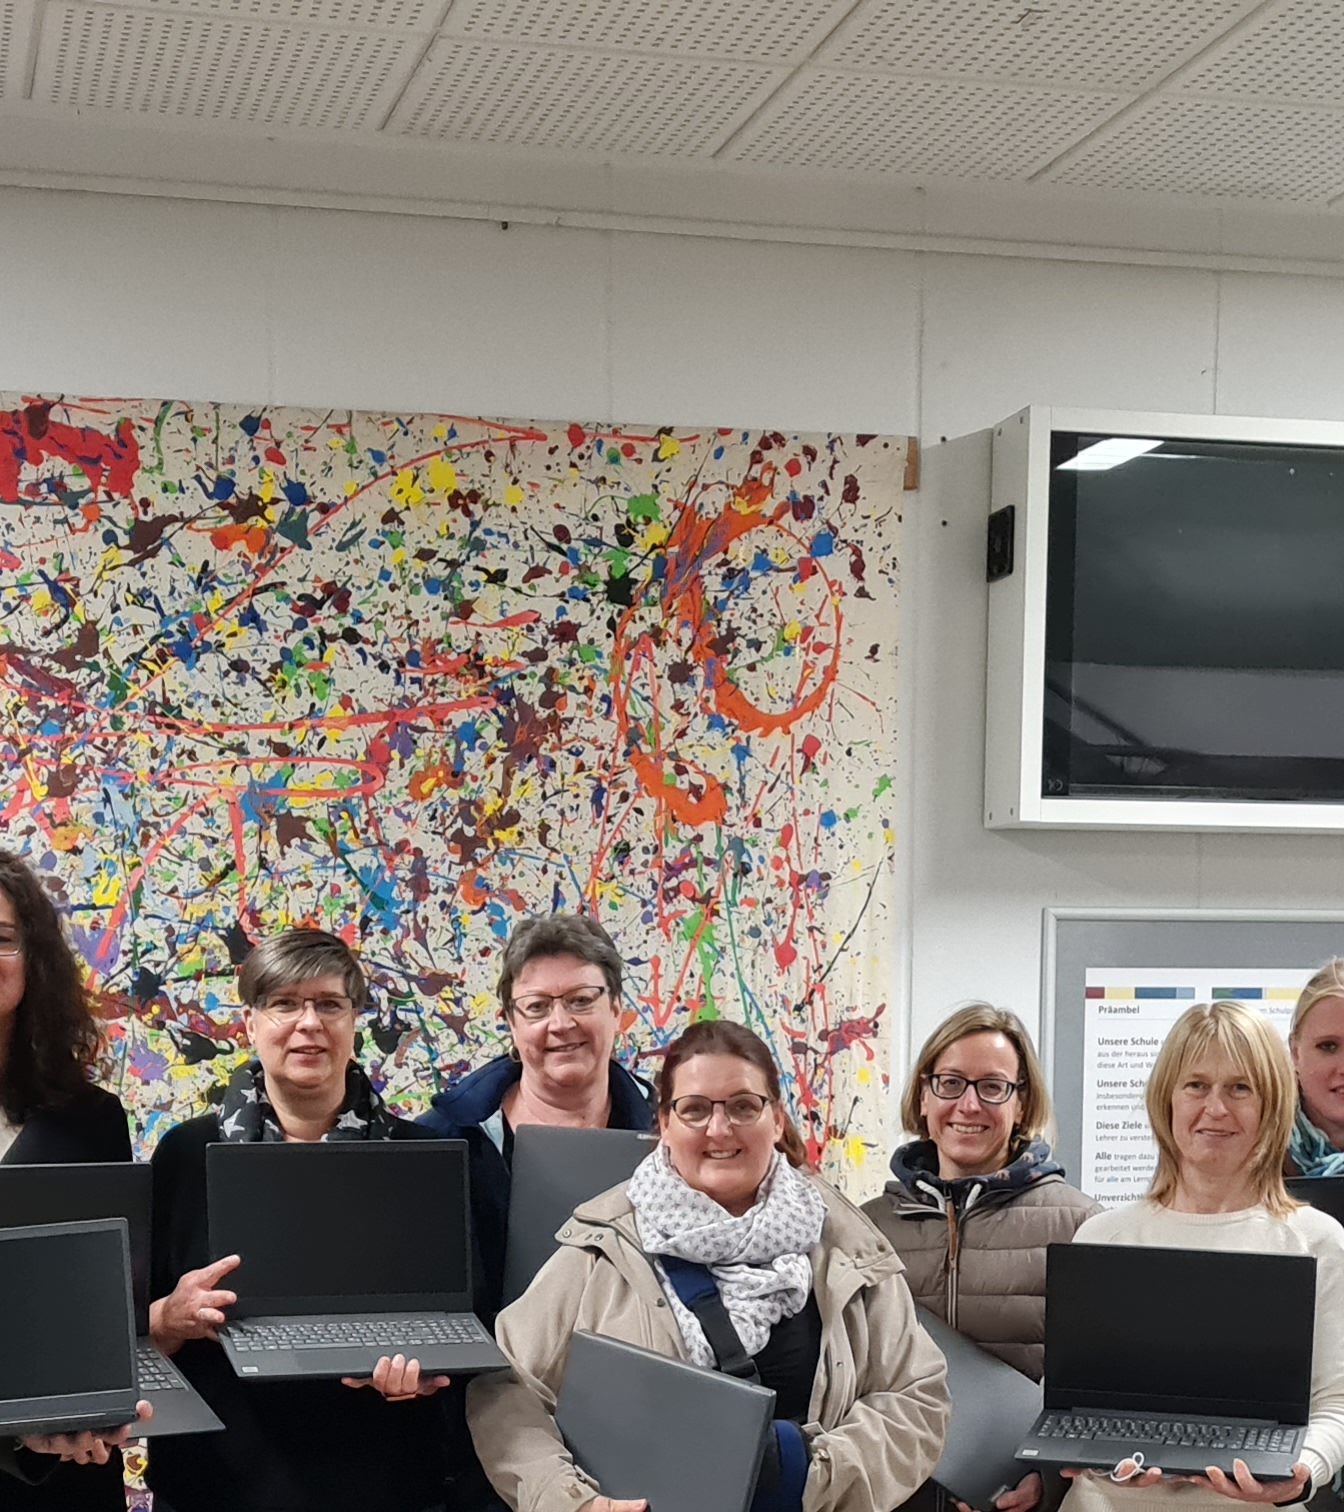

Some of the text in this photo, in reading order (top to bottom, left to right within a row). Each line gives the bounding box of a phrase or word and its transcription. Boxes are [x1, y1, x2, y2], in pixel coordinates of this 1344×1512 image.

[1098, 1005, 1140, 1014] Präambel
[1097, 1037, 1128, 1046] Unsere
[1130, 1037, 1159, 1046] Schule
[1111, 1050, 1123, 1058] der
[1124, 1050, 1149, 1058] heraus
[1097, 1061, 1116, 1069] diese
[1117, 1061, 1129, 1069] Art
[1130, 1061, 1144, 1069] und
[1097, 1079, 1128, 1088] Unsere
[1129, 1079, 1146, 1088] Sch
[1096, 1121, 1120, 1130] Diese
[1121, 1121, 1143, 1130] Ziele
[1096, 1134, 1118, 1142] Lehrer
[1095, 1152, 1155, 1162] Alle tragen dazu
[1095, 1164, 1131, 1174] gearbeitet
[1095, 1176, 1105, 1184] für
[1106, 1176, 1119, 1184] alle
